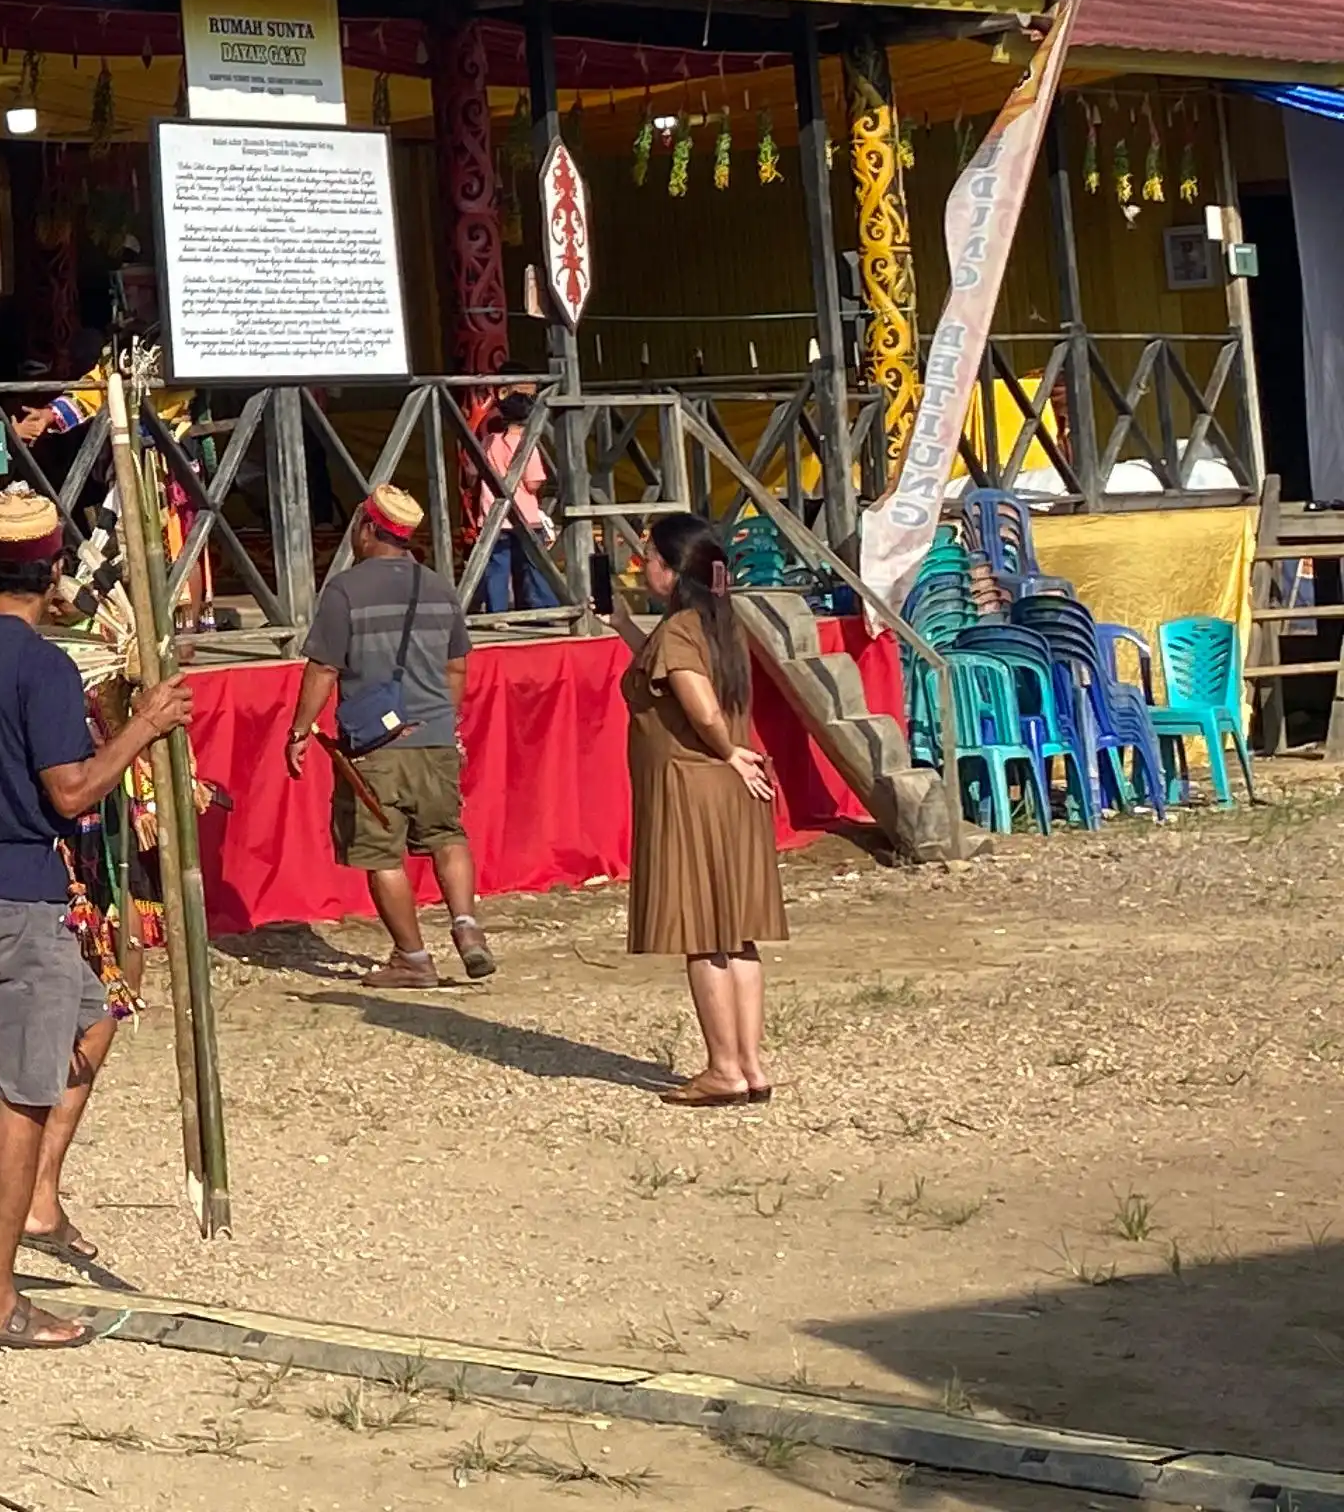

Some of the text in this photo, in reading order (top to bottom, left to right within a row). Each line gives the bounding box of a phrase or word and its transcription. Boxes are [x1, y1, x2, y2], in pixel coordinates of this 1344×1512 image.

[208, 16, 315, 39] RUMAH SUNTA
[220, 42, 268, 64] DAYAK
